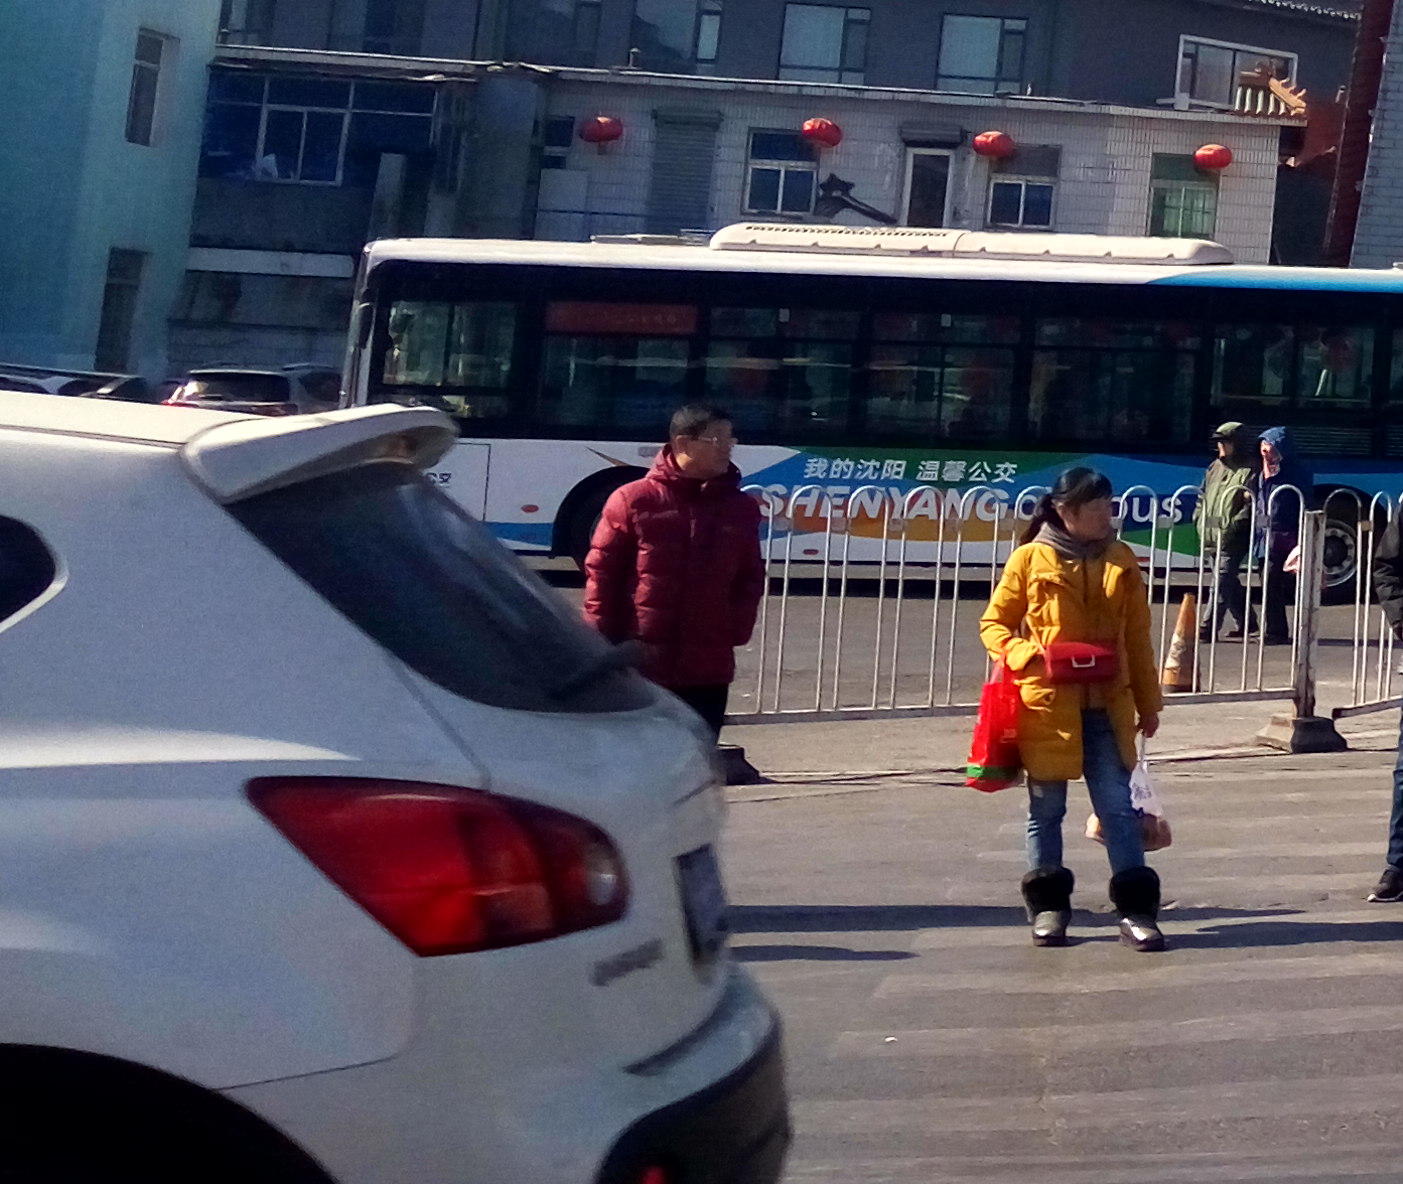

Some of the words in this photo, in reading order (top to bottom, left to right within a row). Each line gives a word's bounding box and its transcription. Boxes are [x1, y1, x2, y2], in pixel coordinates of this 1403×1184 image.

[804, 457, 906, 481] 我的沈阳
[916, 460, 1018, 484] 温馨公交
[760, 484, 1011, 522] SHENYANG
